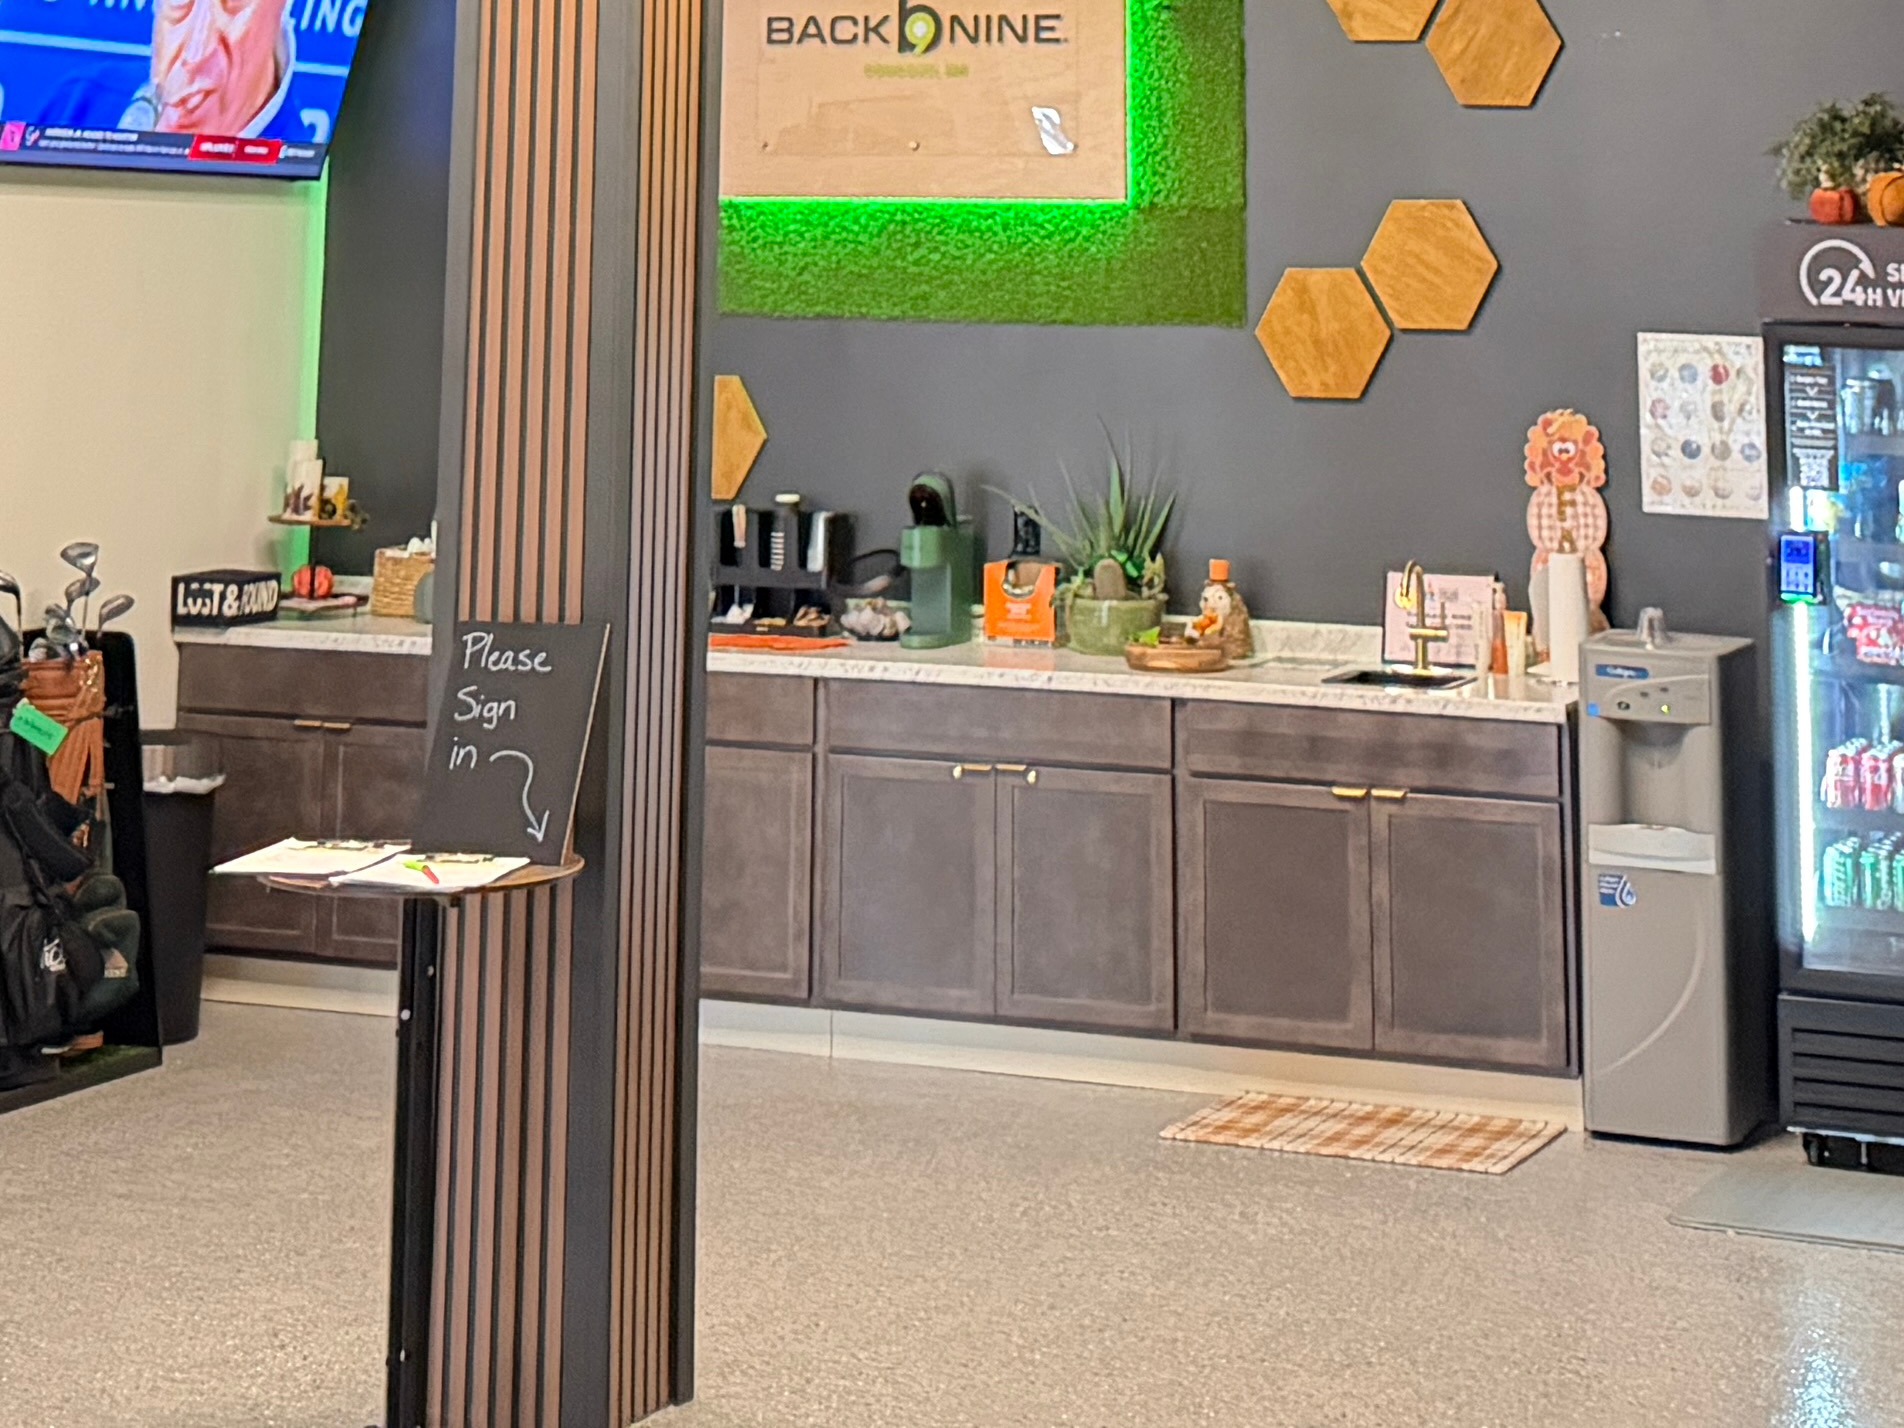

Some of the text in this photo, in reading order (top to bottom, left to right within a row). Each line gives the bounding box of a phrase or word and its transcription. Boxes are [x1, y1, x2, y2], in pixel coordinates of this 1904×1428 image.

[767, 15, 891, 45] BACK
[950, 14, 1063, 44] NINE
[177, 582, 224, 616] LOST
[222, 584, 240, 617] &
[462, 631, 552, 672] Please
[454, 685, 516, 729] Sign
[449, 737, 478, 770] in
